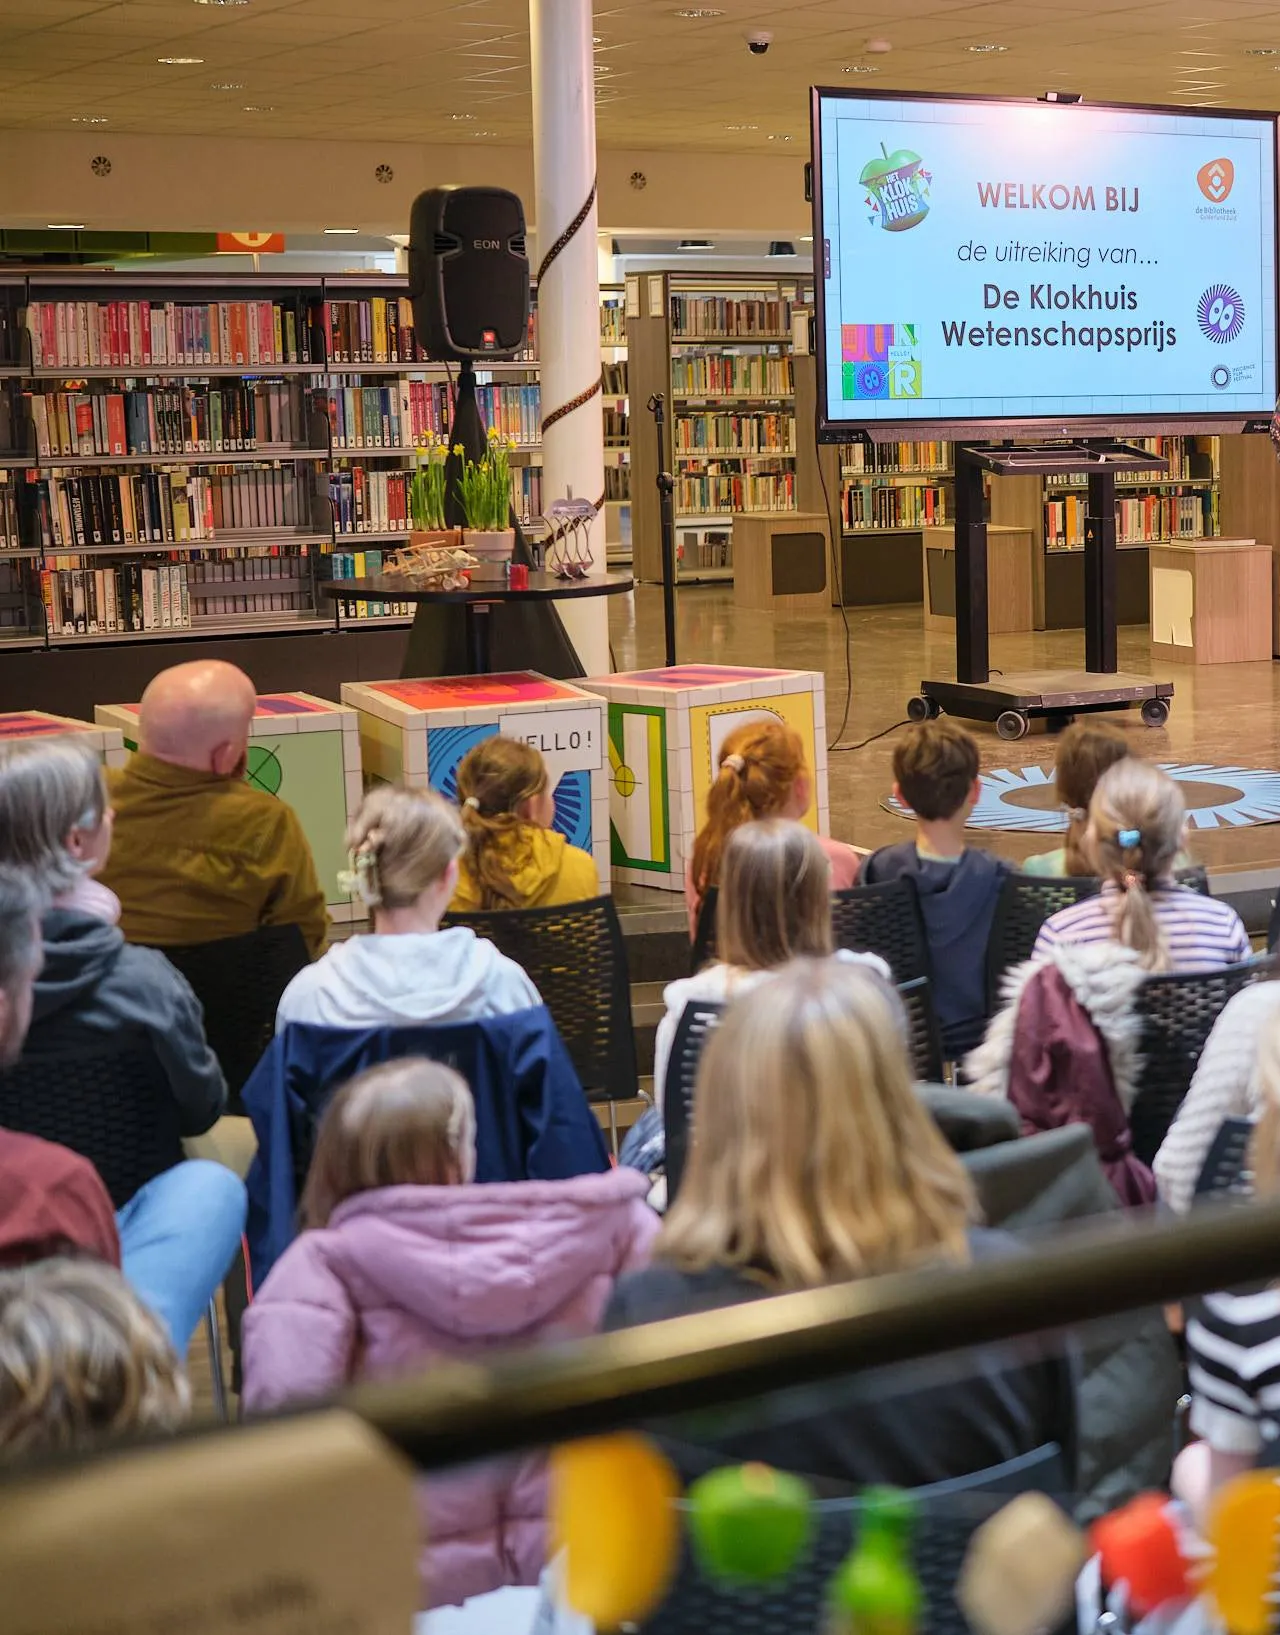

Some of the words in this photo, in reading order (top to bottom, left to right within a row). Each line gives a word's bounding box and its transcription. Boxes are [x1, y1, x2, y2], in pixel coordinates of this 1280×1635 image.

[880, 177, 914, 203] KLOK
[886, 171, 899, 183] HET
[886, 194, 919, 220] HUIS
[977, 182, 1096, 211] WELKOM
[1105, 186, 1139, 212] BIJ
[473, 239, 500, 249] EON
[957, 240, 987, 261] de
[995, 240, 1091, 268] uitreiking
[1098, 247, 1158, 264] van...
[983, 284, 1020, 309] De
[1030, 284, 1138, 310] Klokhuis
[941, 320, 1177, 352] Wetenschapsprijs
[511, 731, 591, 752] ELLO!
